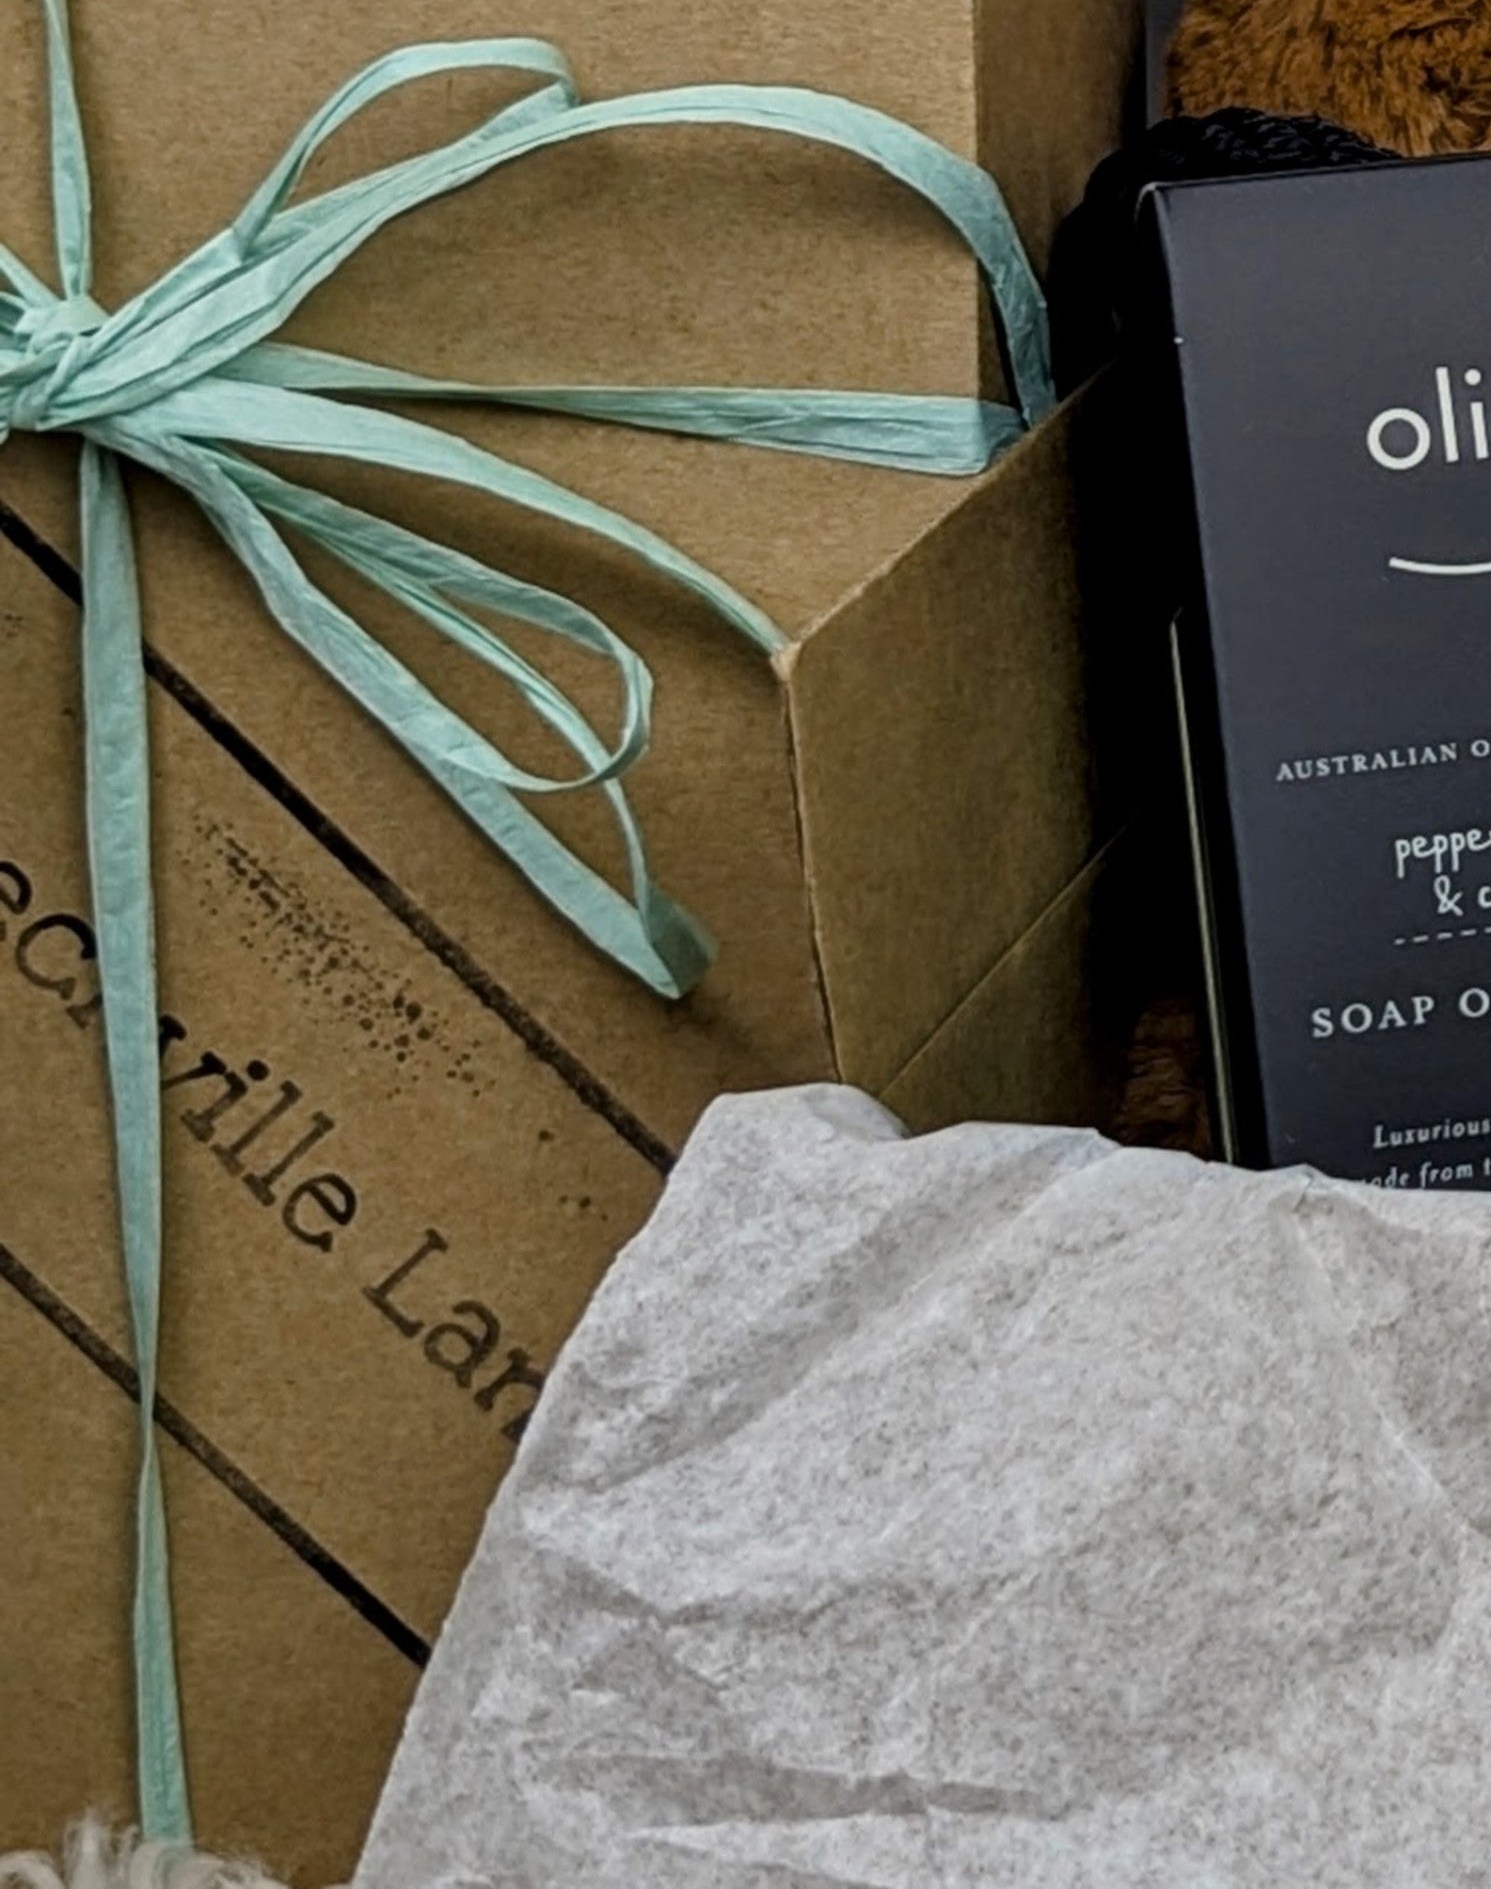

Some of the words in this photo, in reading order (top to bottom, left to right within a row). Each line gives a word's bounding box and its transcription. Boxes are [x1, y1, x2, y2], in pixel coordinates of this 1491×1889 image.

[1276, 742, 1458, 781] AUSTRALIAN
[1435, 876, 1463, 916] &
[1312, 995, 1436, 1038] SOAP
[1373, 1116, 1491, 1148] Luxurious
[1361, 1167, 1409, 1189] ade
[1418, 1161, 1474, 1188] from
